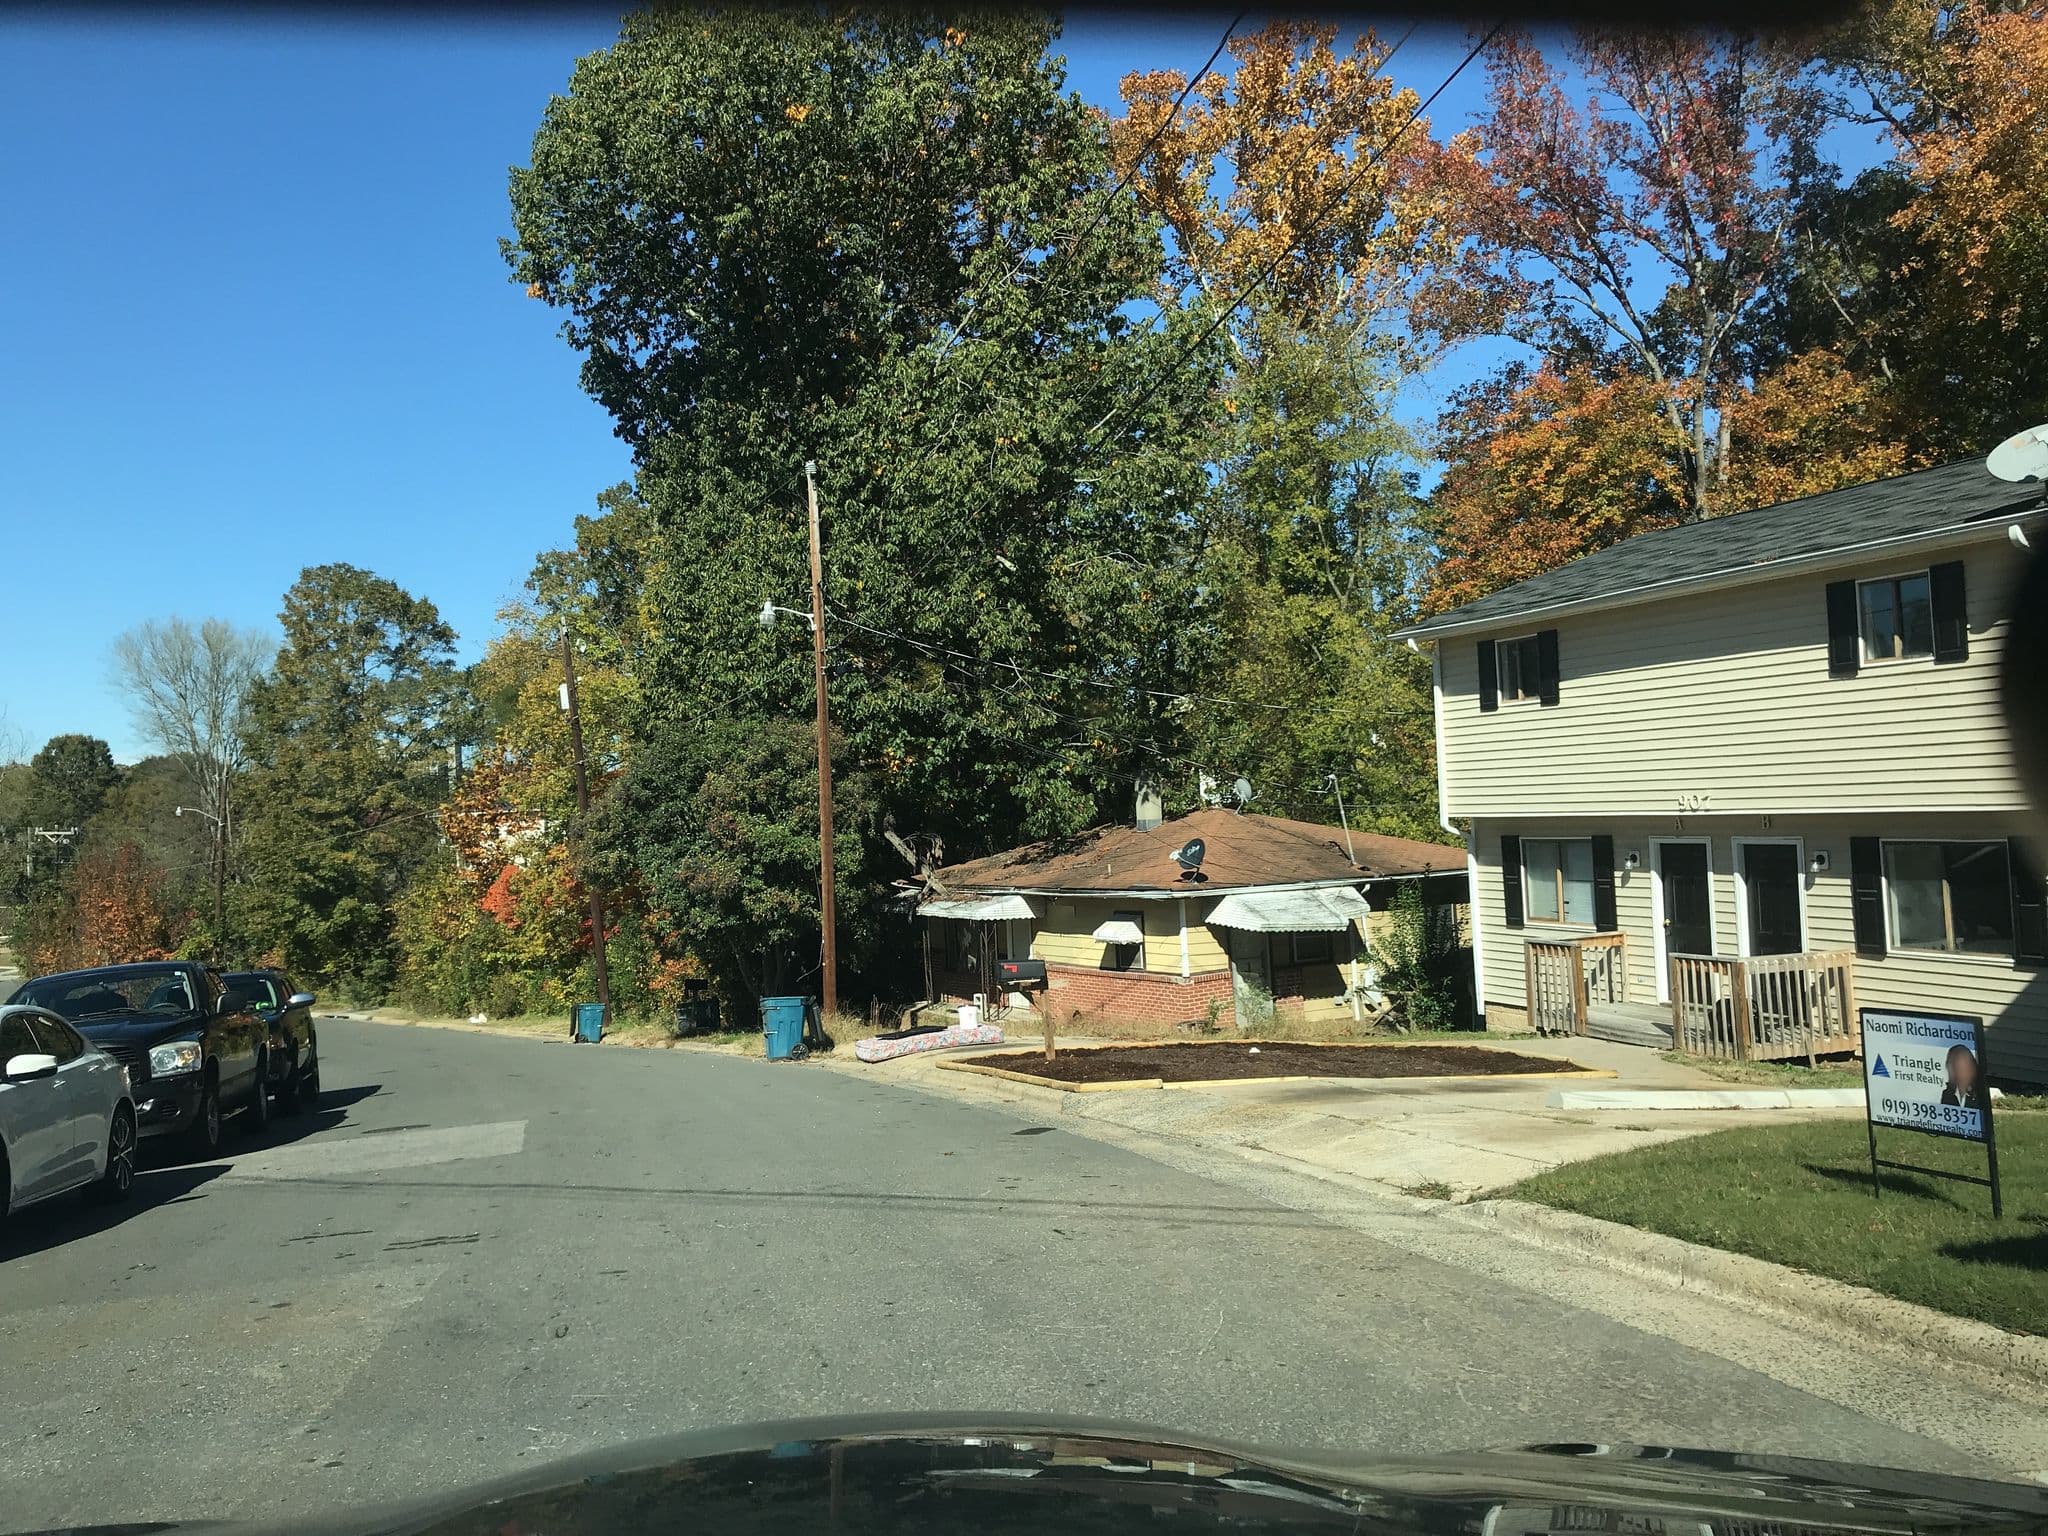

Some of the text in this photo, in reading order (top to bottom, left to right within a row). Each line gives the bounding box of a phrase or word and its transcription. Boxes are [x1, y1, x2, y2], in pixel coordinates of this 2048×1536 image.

[1679, 794, 1711, 812] 907
[1674, 816, 1685, 831] A
[1761, 815, 1771, 830] B
[1866, 1018, 1975, 1041] Naomi Richardson
[1892, 1054, 1942, 1073] Triangle
[1894, 1070, 1944, 1087] First Realty
[1882, 1098, 1977, 1126] (919) 398-8357
